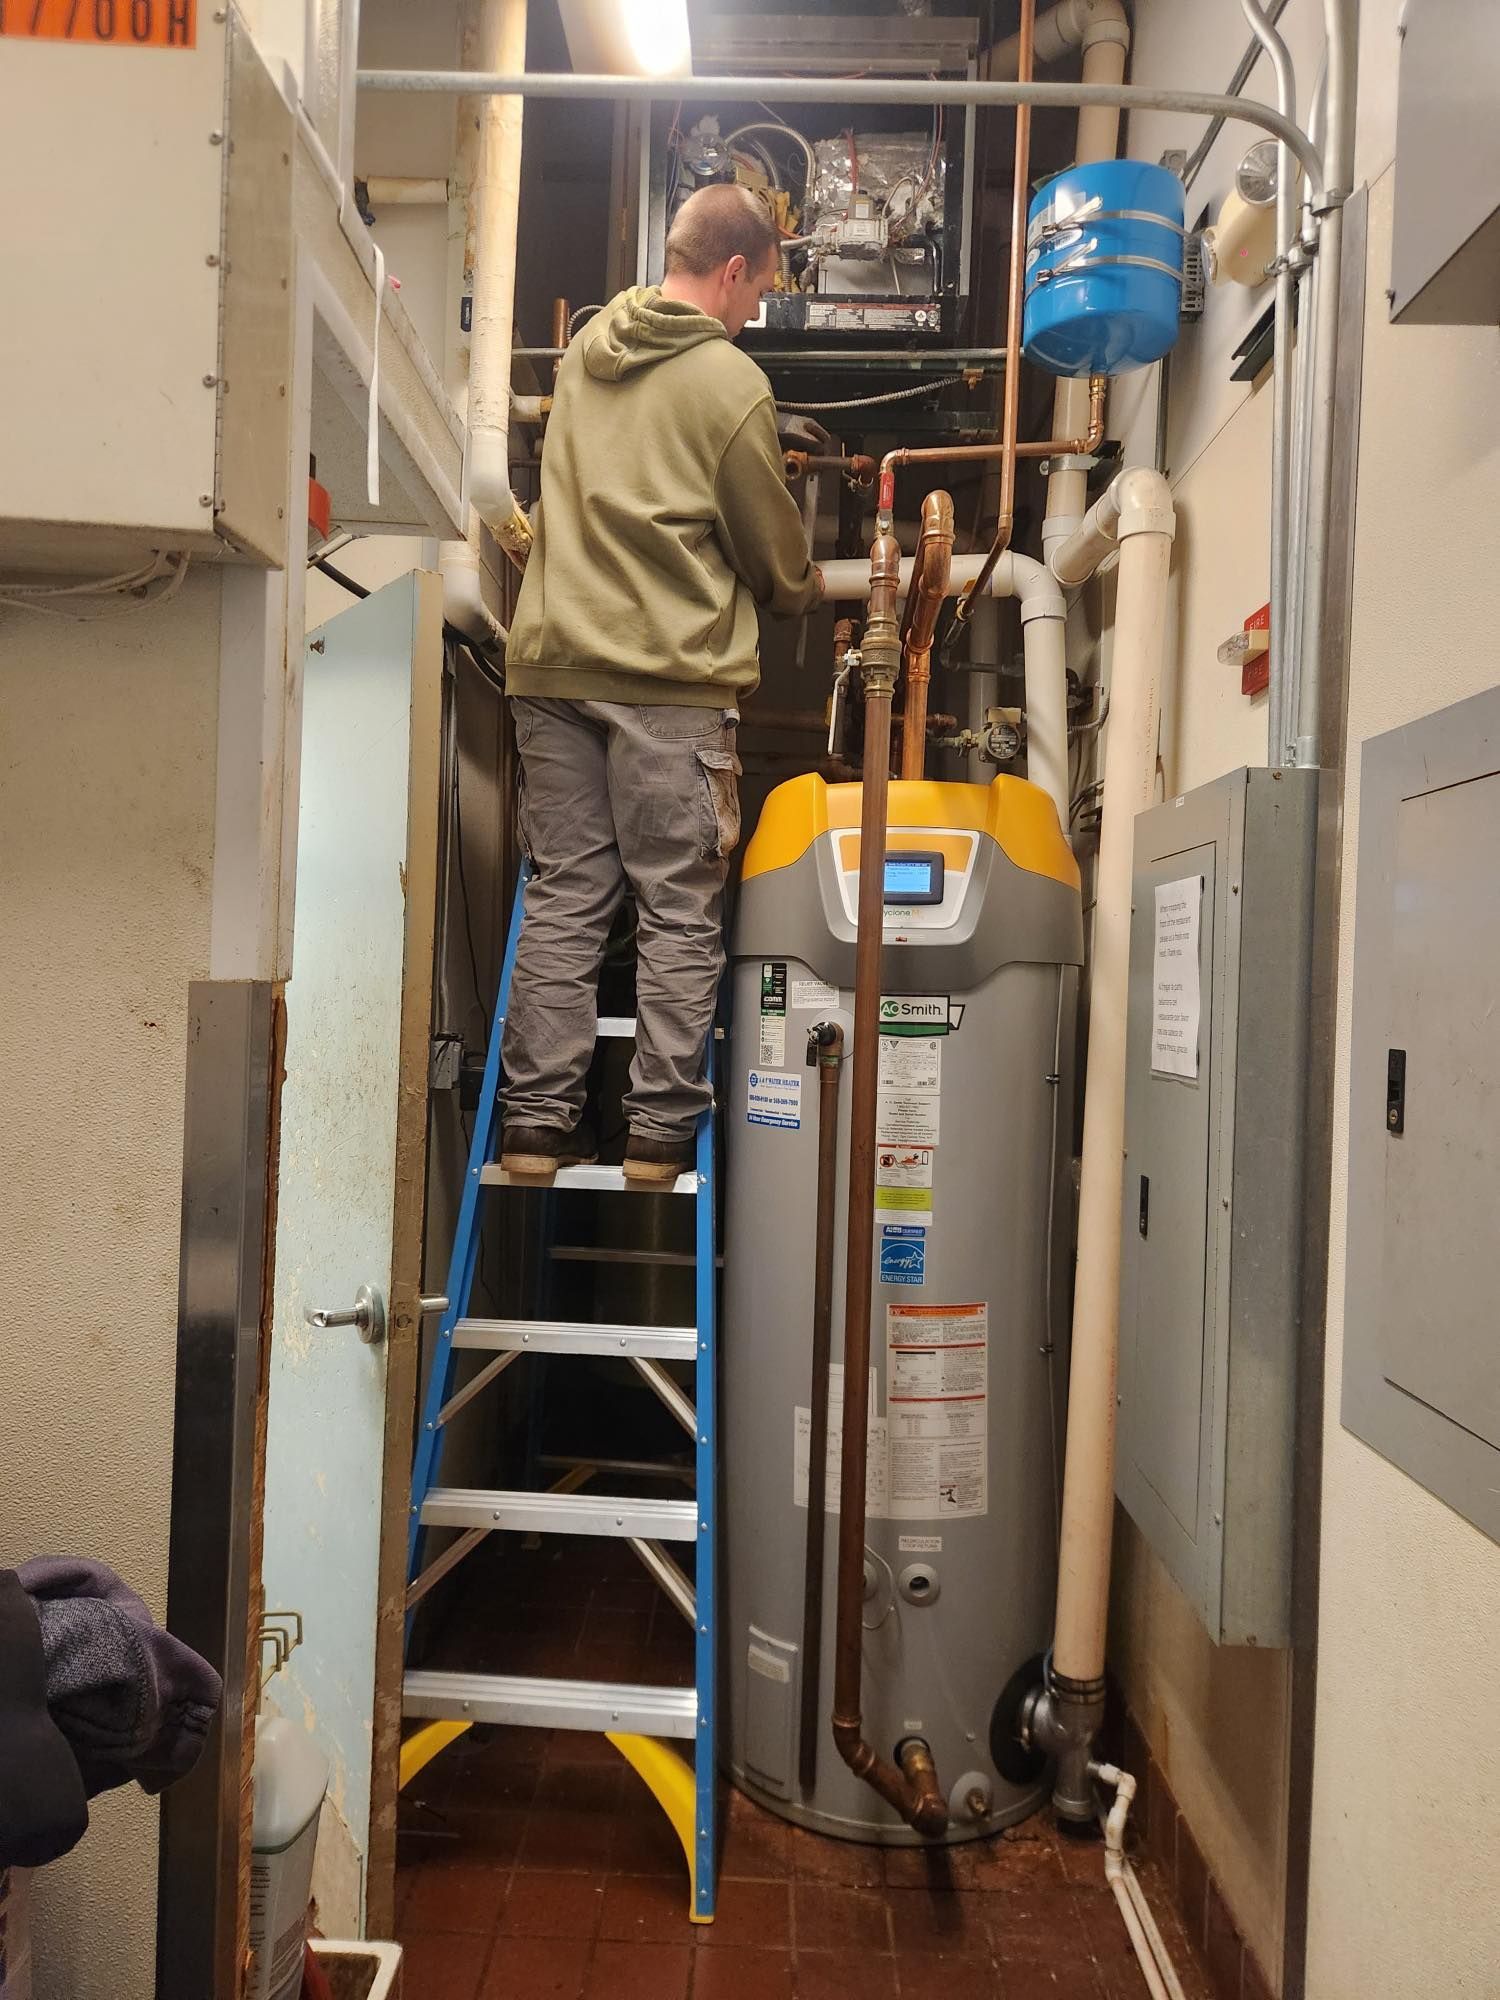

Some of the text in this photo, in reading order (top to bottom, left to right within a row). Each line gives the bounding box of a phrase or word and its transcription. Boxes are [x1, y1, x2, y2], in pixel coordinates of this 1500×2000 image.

[1249, 613, 1265, 630] FIRE
[883, 909, 910, 917] yclone
[901, 1003, 941, 1016] Smith
[882, 1274, 923, 1284] ENERGY STAR
